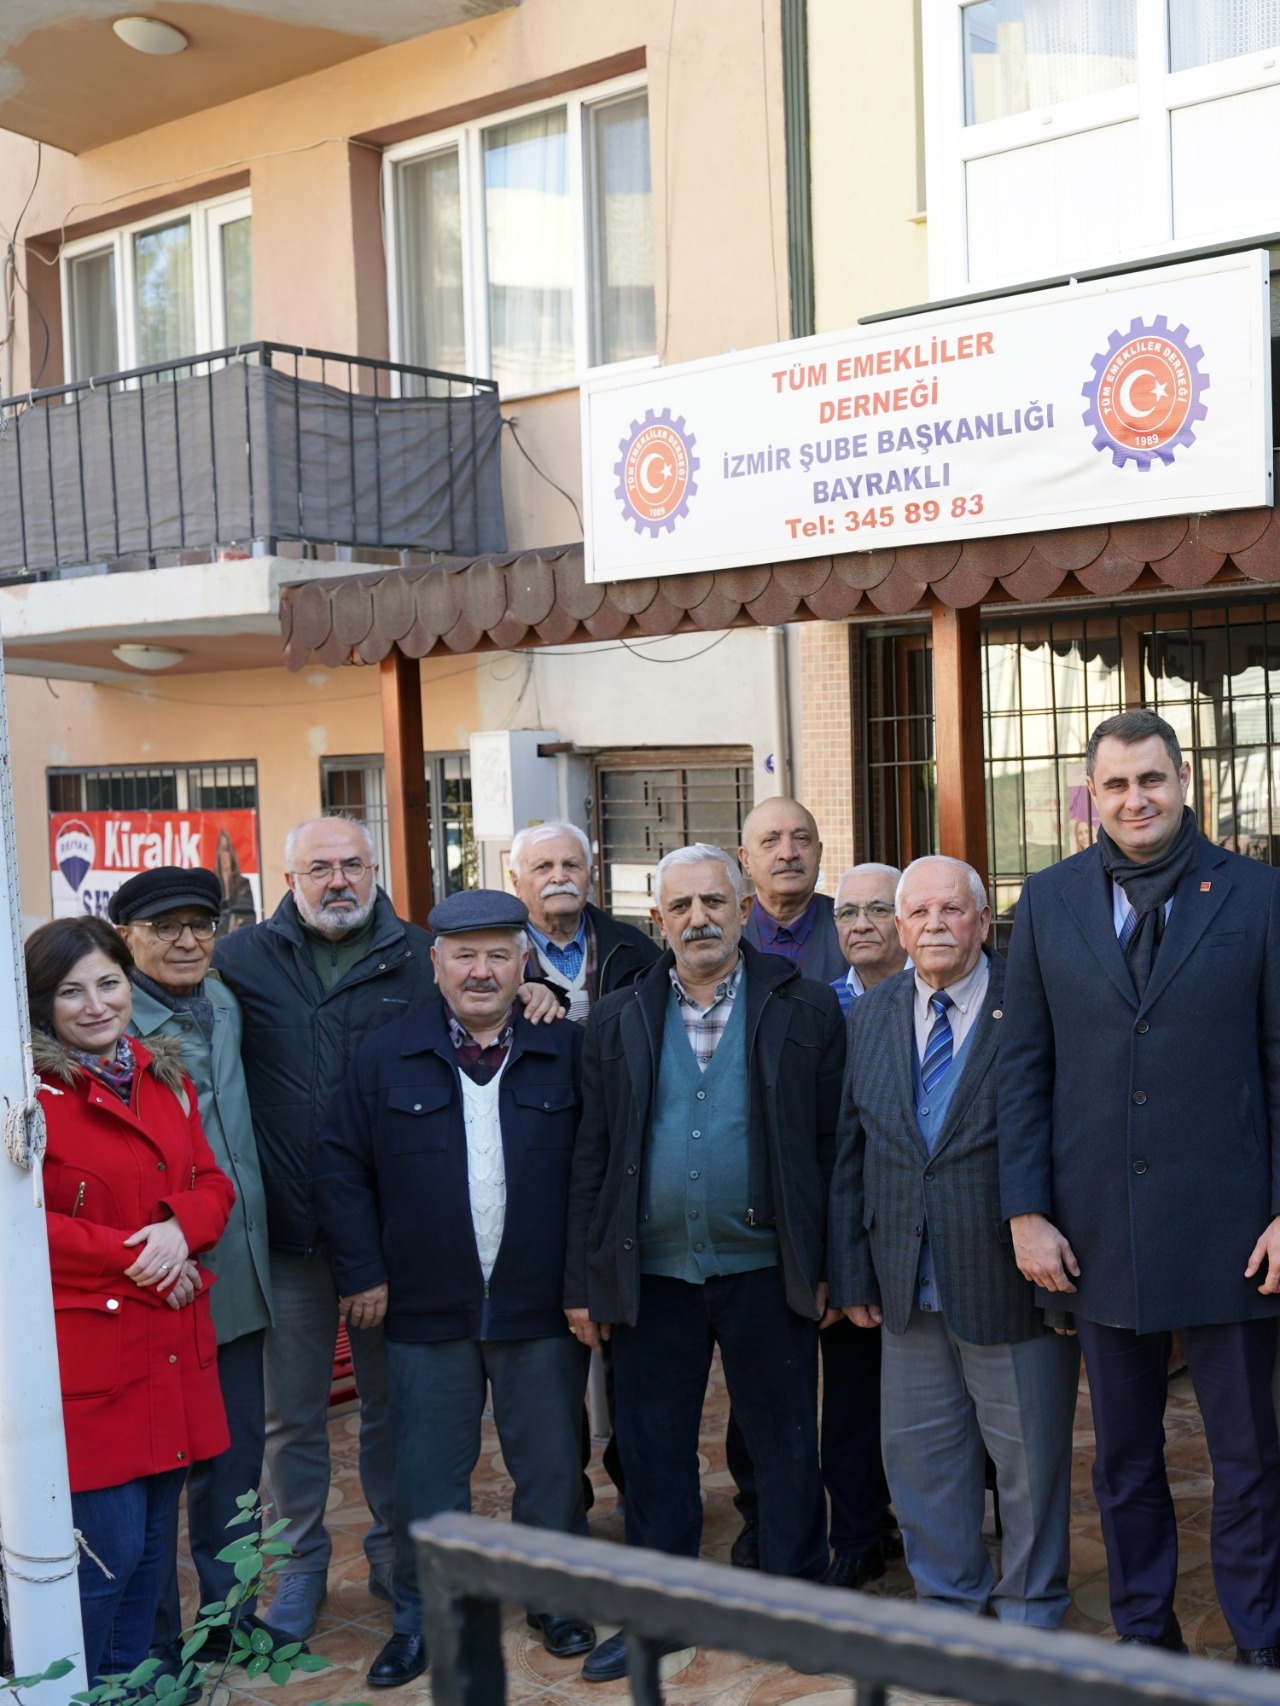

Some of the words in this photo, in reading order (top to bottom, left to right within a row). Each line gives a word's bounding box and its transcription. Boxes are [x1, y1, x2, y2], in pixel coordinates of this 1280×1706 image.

[771, 363, 828, 394] TÜM
[836, 331, 995, 382] EMEKLİLER
[1107, 341, 1162, 383] EMEKLİLER
[819, 376, 940, 424] DERNEĞİ
[723, 444, 792, 480] İZMİR
[799, 433, 868, 473] ŞUBE
[877, 400, 1055, 455] BAŞKANLIĞI
[1135, 433, 1159, 446] 1989
[812, 462, 951, 505] BAYRAKLI
[785, 515, 836, 540] Tel:
[844, 505, 895, 533] 345
[904, 499, 941, 525] 89
[950, 493, 985, 519] 83
[104, 820, 201, 868] Kiralık
